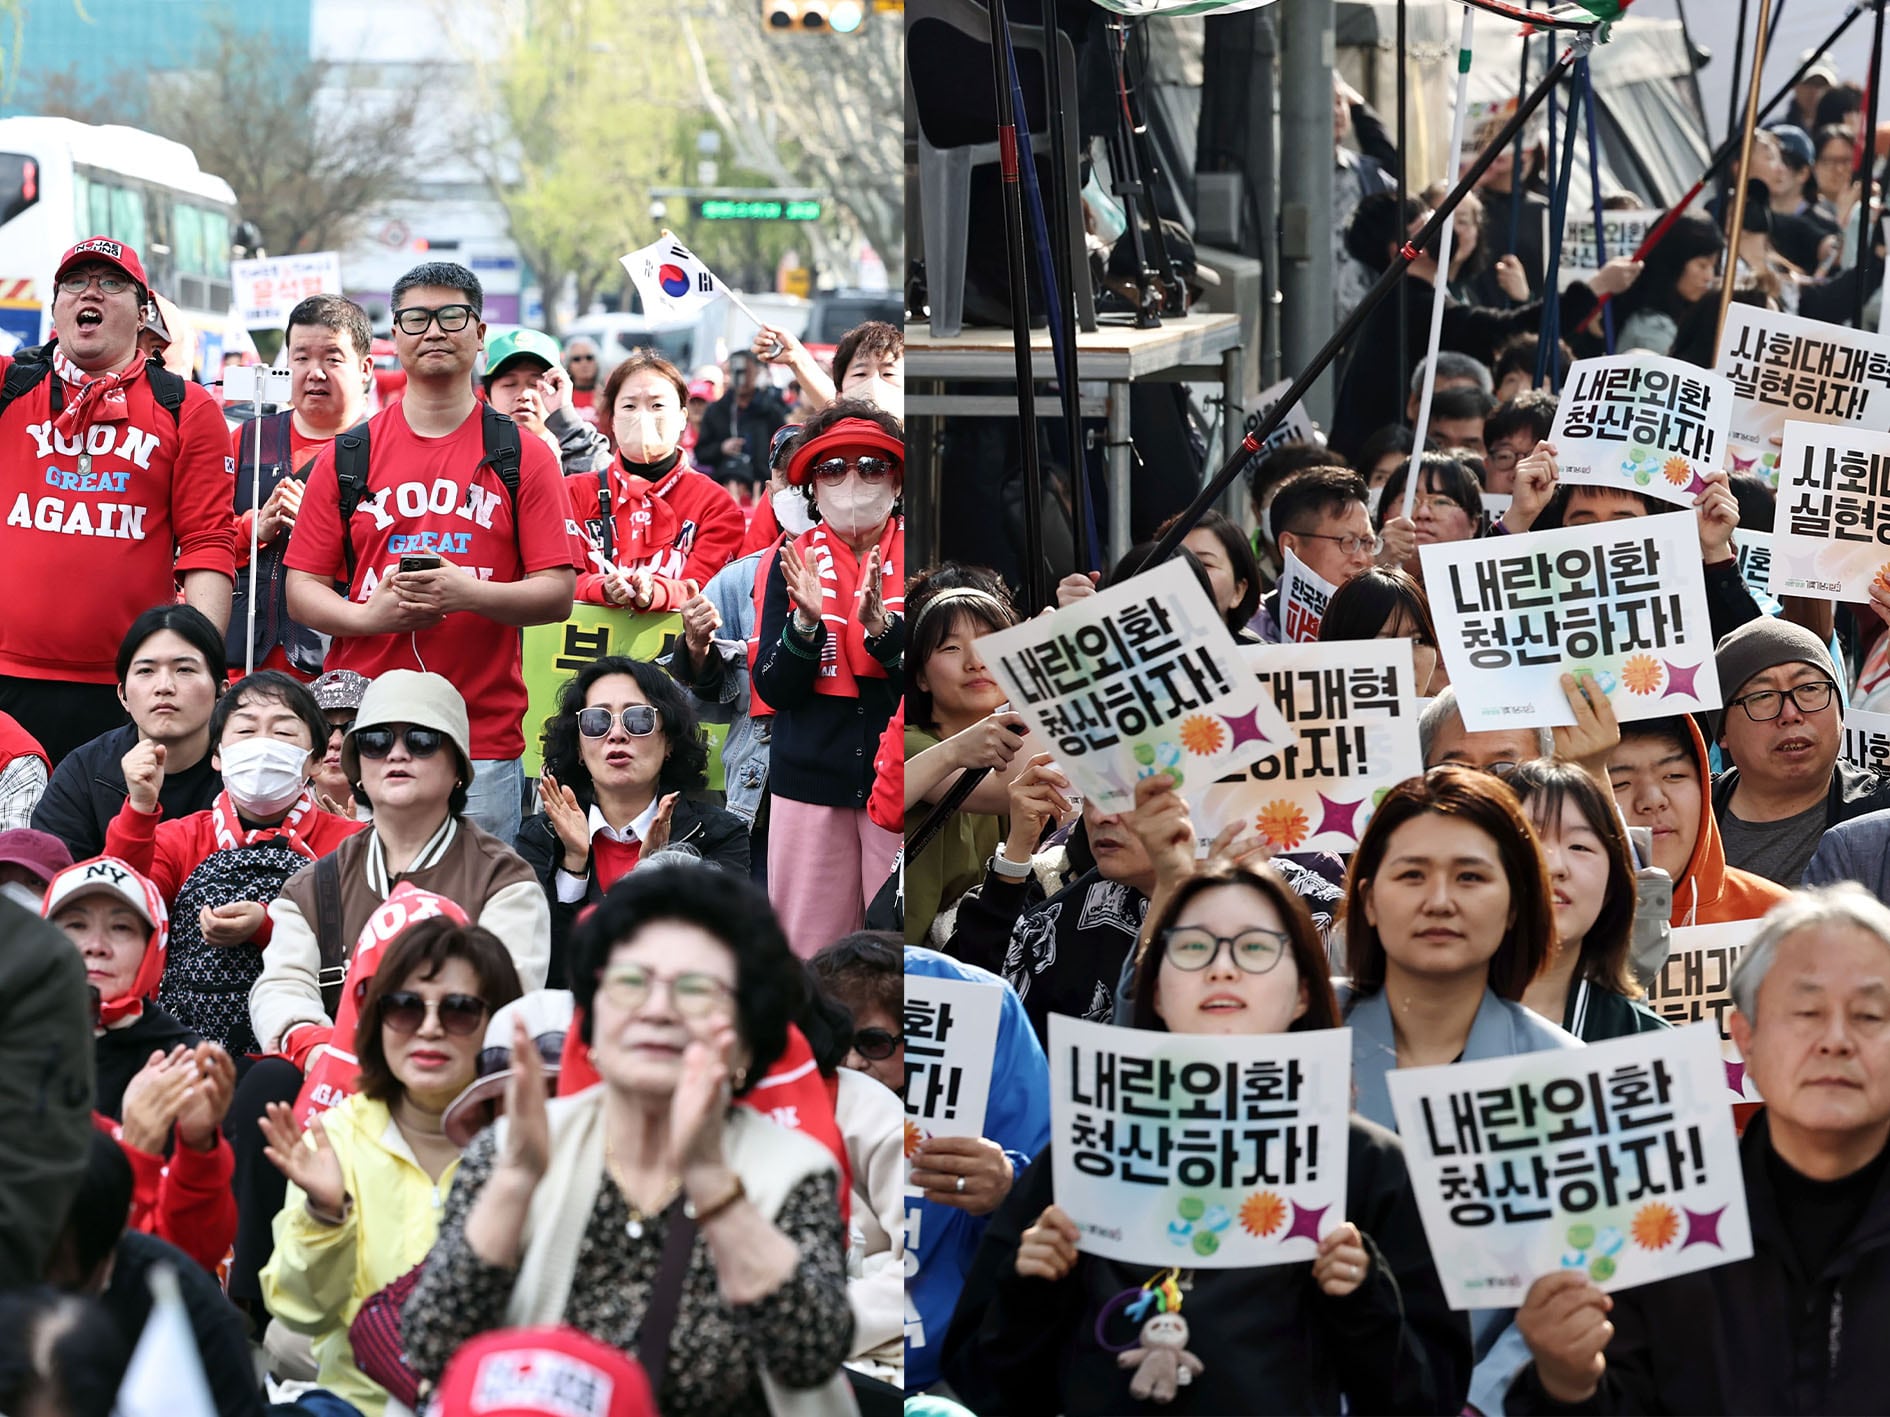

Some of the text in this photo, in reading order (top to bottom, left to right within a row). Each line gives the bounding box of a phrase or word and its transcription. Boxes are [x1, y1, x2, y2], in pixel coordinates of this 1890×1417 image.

[1573, 367, 1712, 421] 내란외환
[1726, 363, 1869, 420] 실현하자!
[26, 422, 161, 470] YOON
[1562, 406, 1715, 463] 청산하자!
[45, 466, 131, 493] GREAT
[1793, 445, 1890, 498] 사회
[6, 493, 147, 541] AGAIN
[357, 479, 502, 532] YOON
[387, 531, 473, 555] GREAT
[1448, 538, 1661, 613] 내란외환
[1001, 597, 1182, 705] 내란외환
[1462, 594, 1684, 669] 청산하자!
[1039, 647, 1231, 757] 청산하자!
[1256, 667, 1400, 722] 대개혁
[86, 863, 128, 885] NY
[1071, 1045, 1303, 1121] 내란외환
[1420, 1059, 1674, 1157] 내란외환
[1071, 1114, 1319, 1188] 청산하자!
[1439, 1125, 1707, 1228] 청산하자!
